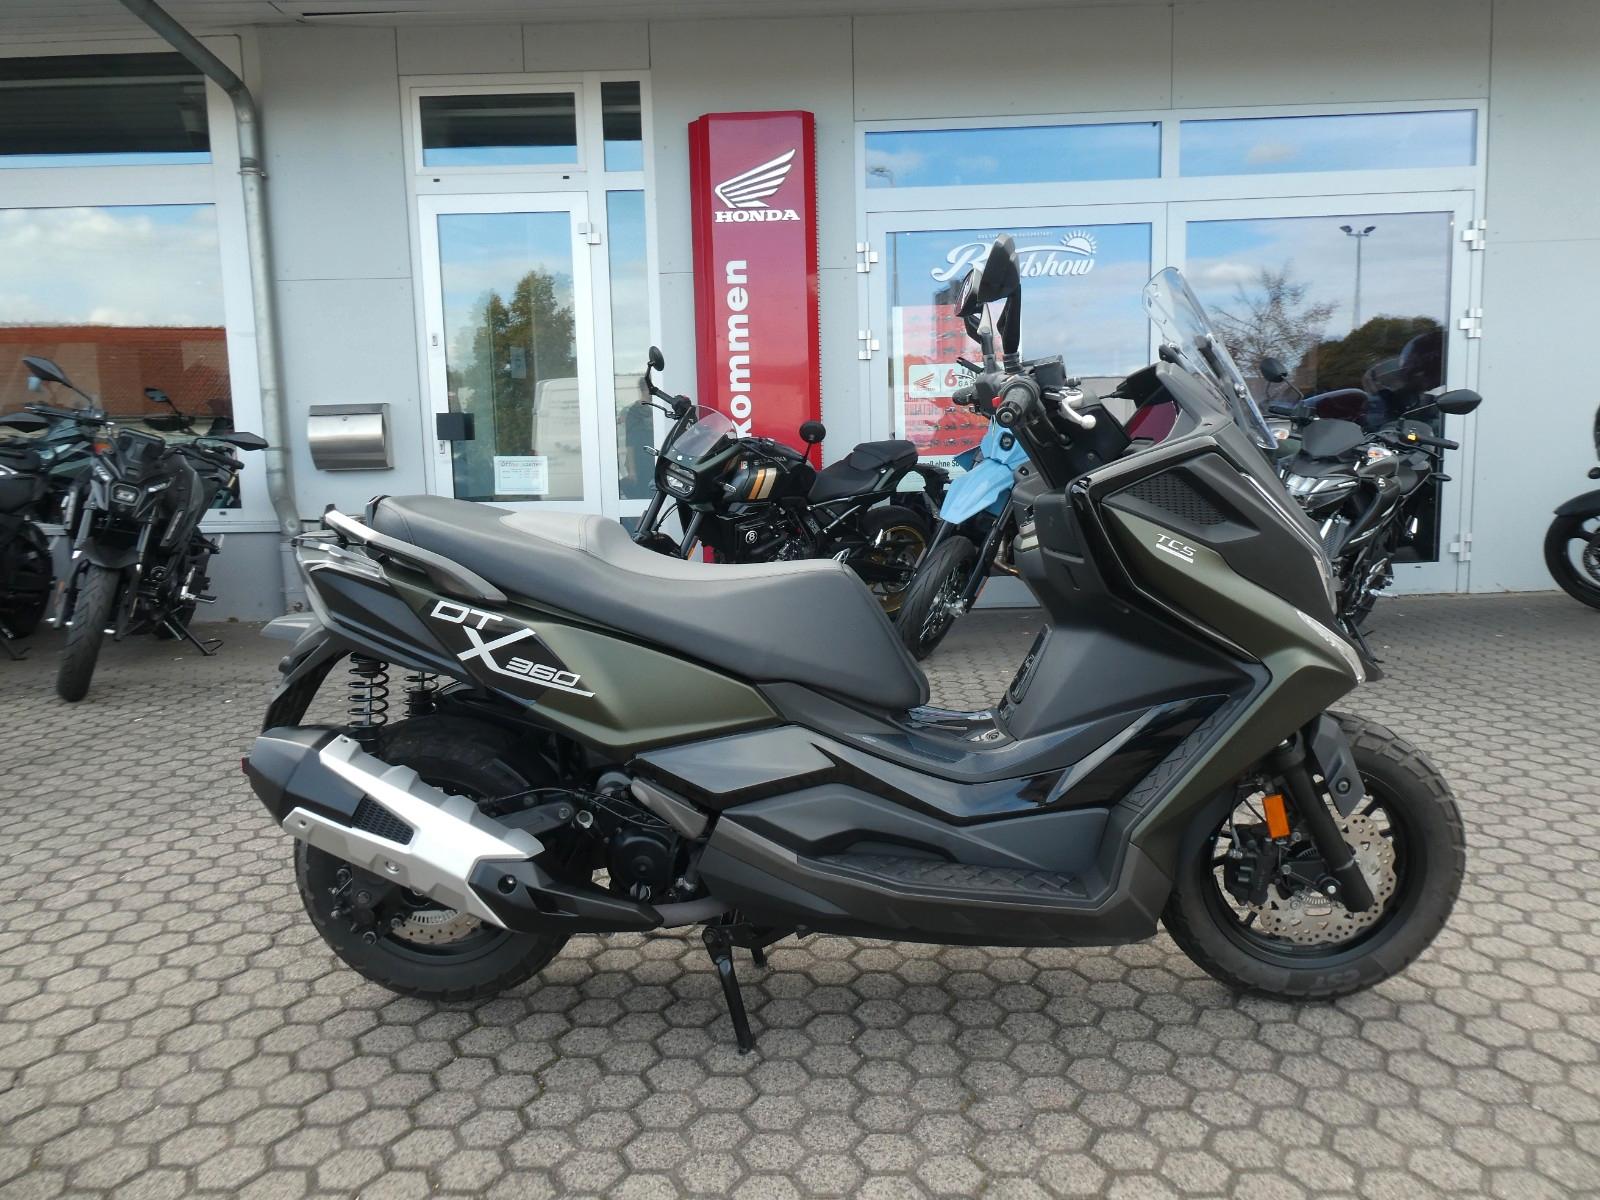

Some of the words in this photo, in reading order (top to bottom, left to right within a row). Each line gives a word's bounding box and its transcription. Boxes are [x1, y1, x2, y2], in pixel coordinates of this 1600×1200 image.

[715, 209, 800, 223] HONDA
[930, 242, 1095, 282] Rdshow
[944, 368, 957, 387] 6
[1156, 533, 1197, 557] TCS
[505, 656, 581, 687] 360
